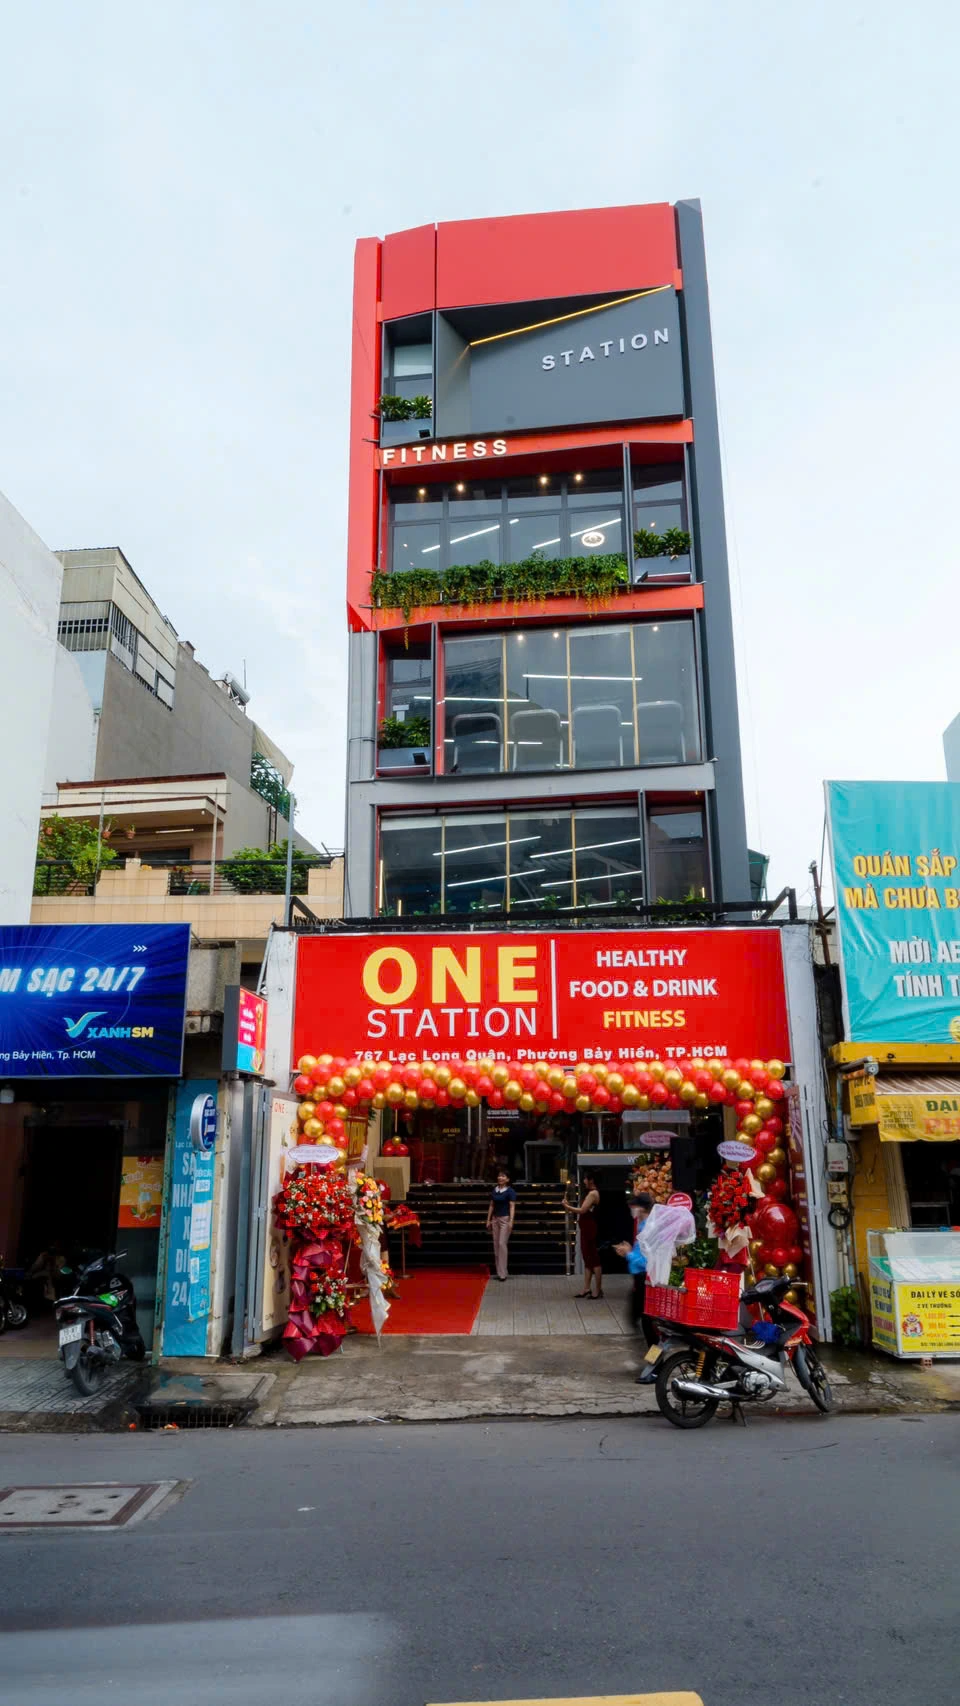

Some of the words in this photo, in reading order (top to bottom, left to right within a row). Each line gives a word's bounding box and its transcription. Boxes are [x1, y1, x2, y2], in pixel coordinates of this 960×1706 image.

[541, 327, 670, 371] STATION
[382, 439, 508, 465] FITNESS
[853, 850, 911, 878] QUÁN
[916, 847, 957, 876] SẮP
[844, 883, 879, 908] MÀ
[884, 885, 941, 908] CHƯA
[596, 949, 688, 968] HEALTHY
[888, 936, 932, 963] MỜI
[27, 967, 76, 997] SẠC
[80, 967, 146, 992] 24/7
[362, 946, 539, 1005] ONE
[569, 980, 629, 998] FOOD
[633, 980, 648, 997] &
[653, 978, 718, 997] DRINK
[893, 971, 944, 997] TÍNH
[367, 1007, 537, 1039] STATION
[603, 1009, 686, 1028] FITNESS
[12, 1050, 30, 1061] Bảy
[57, 1051, 70, 1061] Tp.
[73, 1050, 96, 1060] HCM
[355, 1050, 383, 1061] 767
[388, 1050, 416, 1064] Lạc
[423, 1050, 460, 1061] Long
[466, 1048, 511, 1061] Quân,
[517, 1048, 577, 1061] Phường
[583, 1046, 612, 1061] Bảy
[665, 1046, 728, 1058] TP.HCM
[925, 1100, 958, 1114] ĐẠI
